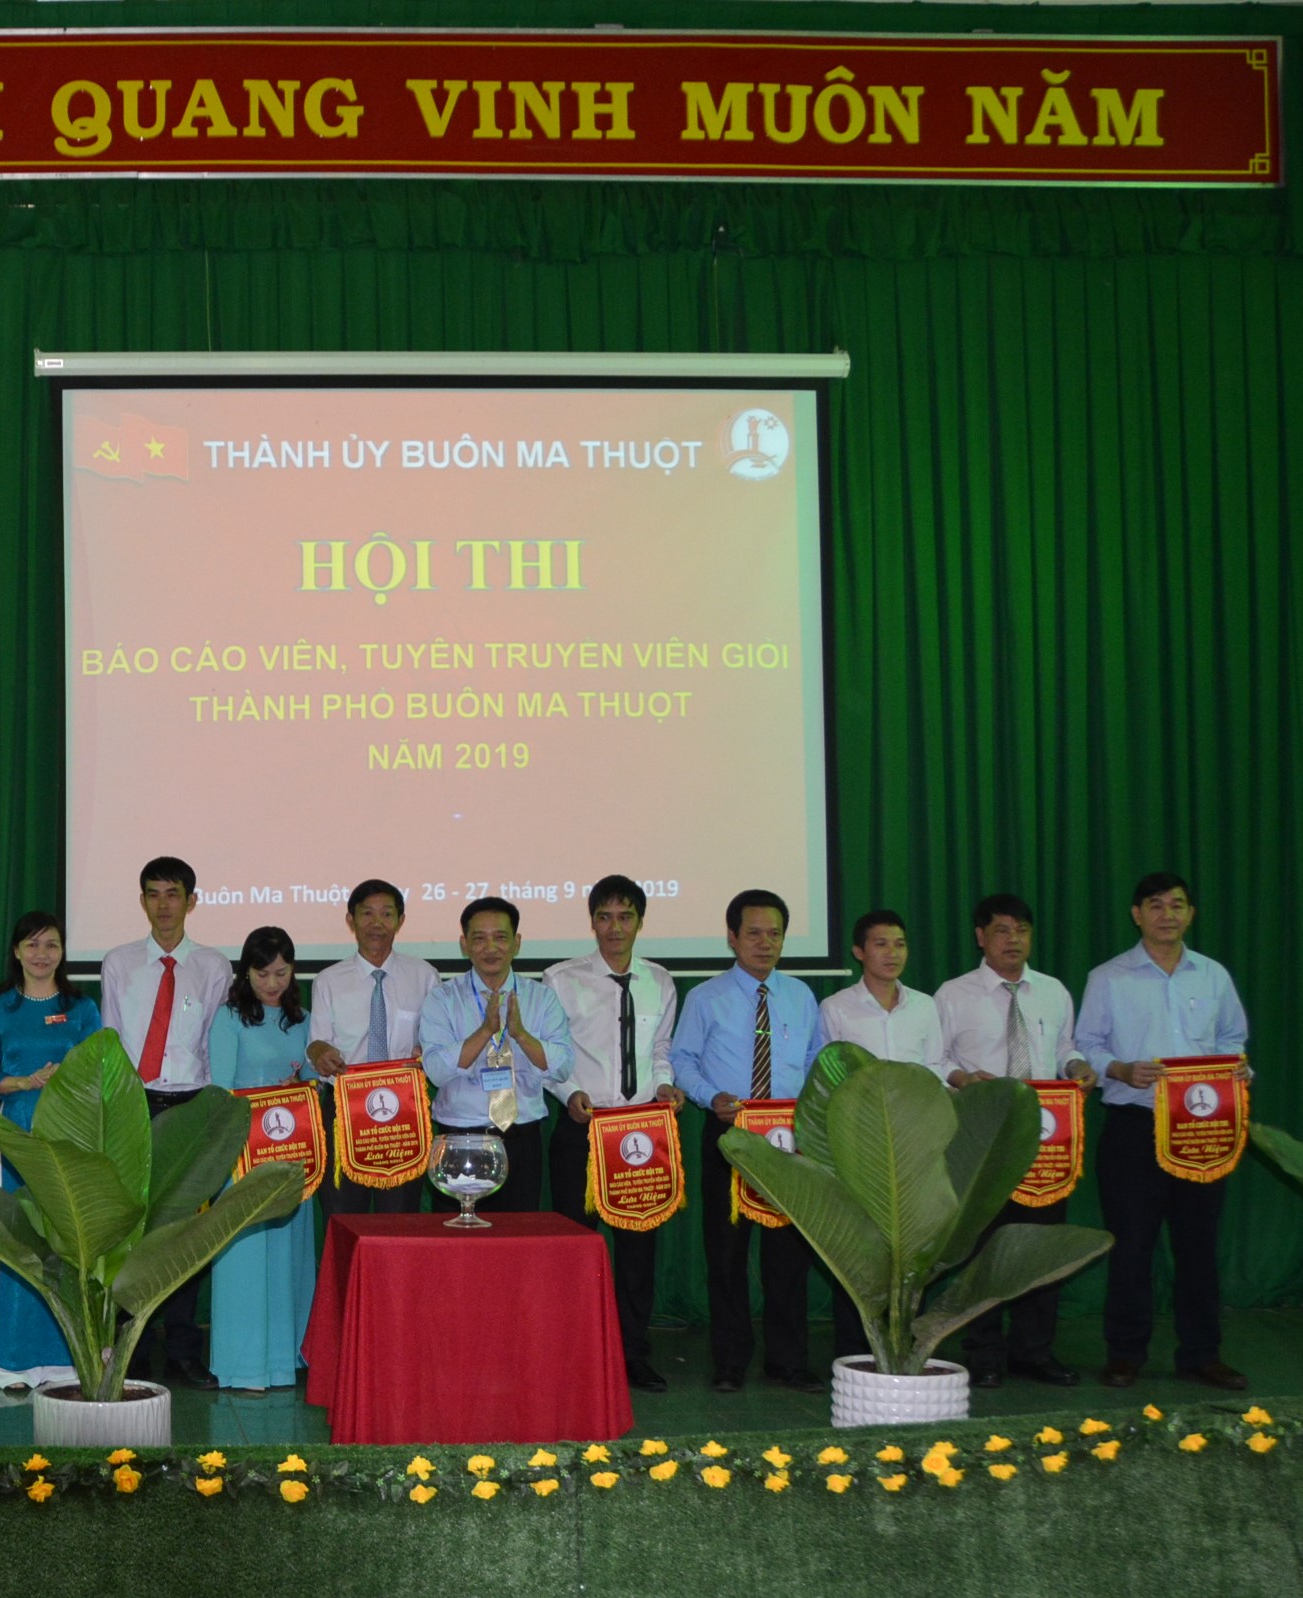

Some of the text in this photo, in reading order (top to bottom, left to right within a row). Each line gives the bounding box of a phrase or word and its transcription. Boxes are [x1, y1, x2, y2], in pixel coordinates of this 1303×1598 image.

[51, 77, 365, 157] QUANG
[407, 79, 636, 140] VINH
[681, 65, 925, 143] MUÔN
[966, 68, 1165, 147] NĂM
[203, 434, 330, 469] THÀNH
[342, 434, 390, 469] ỦY
[402, 433, 504, 469] BUÔN
[517, 440, 570, 469] MA
[295, 531, 586, 605] HỘI THI
[82, 642, 159, 676] BÁO
[171, 640, 247, 673] CÁO
[259, 638, 347, 674] VIÊN,
[359, 637, 474, 669] TUYÊN
[633, 636, 709, 669] VIÊN
[190, 689, 311, 722] THÀNH
[407, 687, 503, 719] BUÔN
[518, 692, 569, 718] MA
[368, 737, 531, 770] NĂM 2019
[250, 887, 283, 904] Ma
[422, 883, 446, 900] 26
[500, 881, 558, 902] tháng
[564, 881, 575, 898] 9
